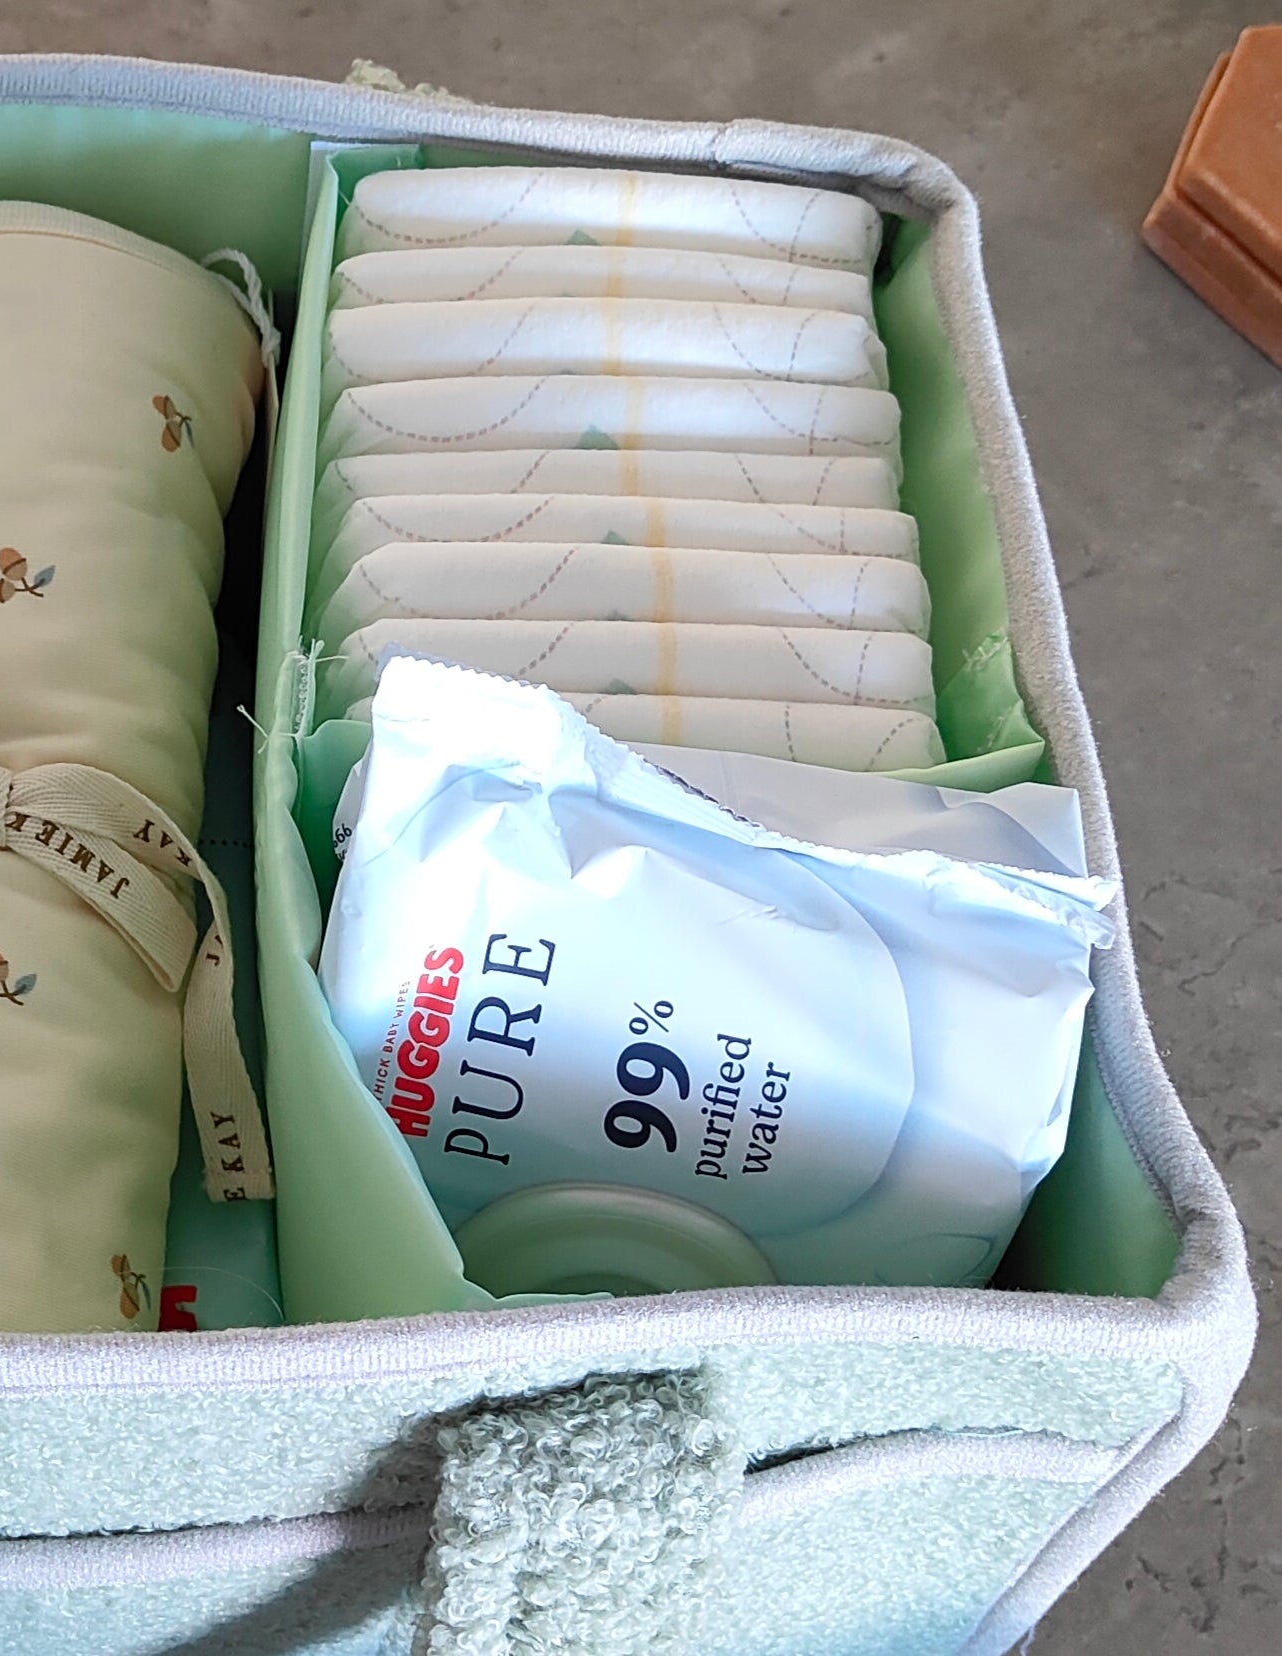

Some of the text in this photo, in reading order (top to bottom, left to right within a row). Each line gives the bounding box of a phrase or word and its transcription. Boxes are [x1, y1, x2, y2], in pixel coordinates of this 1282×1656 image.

[35, 819, 130, 899] JAMIE
[133, 819, 193, 867] KAY
[382, 1022, 400, 1053] BABY
[386, 947, 464, 1137] HUGGIES
[444, 934, 555, 1165] PURE
[604, 1000, 690, 1153] 99%
[210, 1111, 245, 1174] KAY
[694, 1033, 752, 1180] purified
[742, 1062, 791, 1173] water
